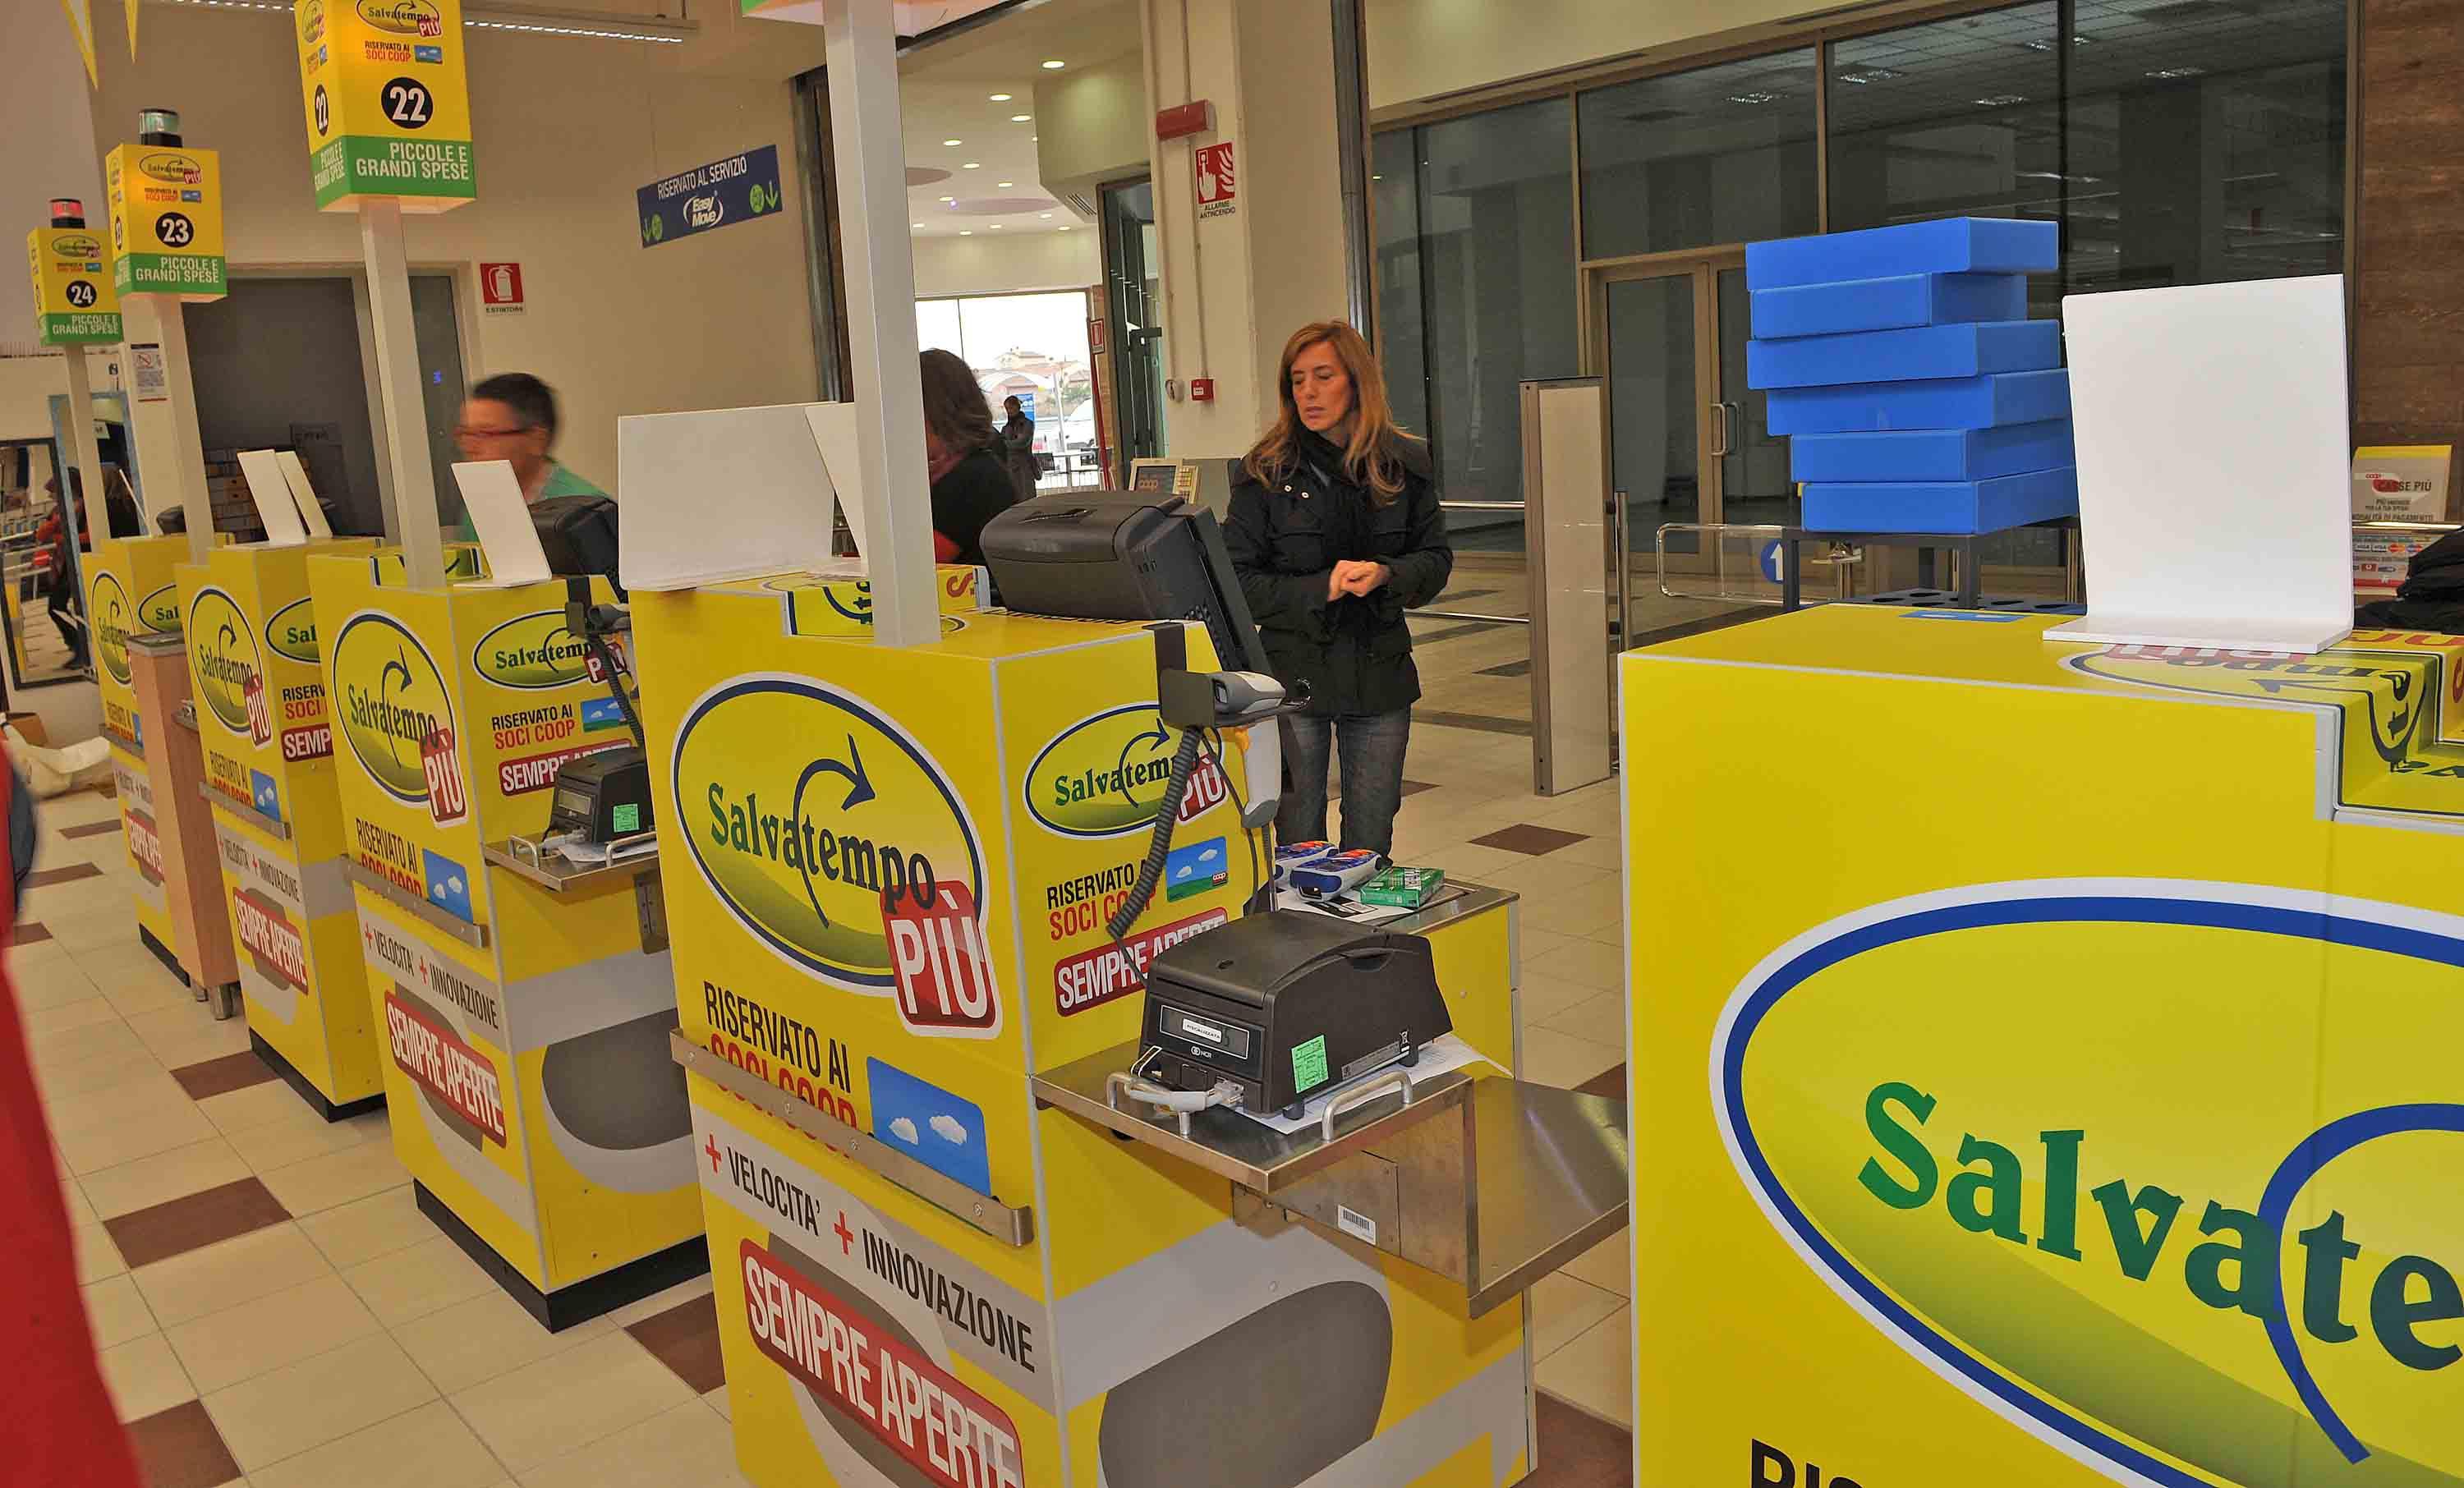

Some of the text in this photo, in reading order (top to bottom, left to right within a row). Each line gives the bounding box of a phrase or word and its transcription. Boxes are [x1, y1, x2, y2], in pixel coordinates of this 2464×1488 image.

[390, 86, 426, 122] 22
[356, 158, 468, 180] GRANDI SPESE
[390, 143, 467, 162] PICCOLE E
[658, 156, 747, 200] RISERVATO AL SERVIZIO
[692, 196, 714, 212] Easy
[692, 210, 717, 227] Move
[162, 218, 189, 243] 23
[136, 269, 180, 282] GRANDI
[184, 270, 218, 283] SPESE
[161, 256, 218, 270] PICCOLE E
[71, 286, 93, 304] 24
[348, 683, 439, 753] Salvatempo
[492, 704, 572, 731] RISERVATO AI
[494, 719, 575, 750] SOCI COOP
[425, 734, 464, 817] PIÙ
[356, 818, 418, 874] RISERVATO AI
[708, 783, 937, 915] Salvatempo
[1047, 864, 1135, 910] RISERVATO
[1050, 909, 1097, 941] SOCI
[891, 889, 988, 1019] PIÙ
[430, 962, 499, 1031] INNOVAZIONE
[704, 981, 851, 1094] RISERVATO AI
[387, 1001, 505, 1138] SEMPRE APERTE
[1857, 1082, 2464, 1371] Salvate
[862, 1228, 1035, 1373] INNOVAZIONE
[745, 1255, 876, 1420] SEMPRE
